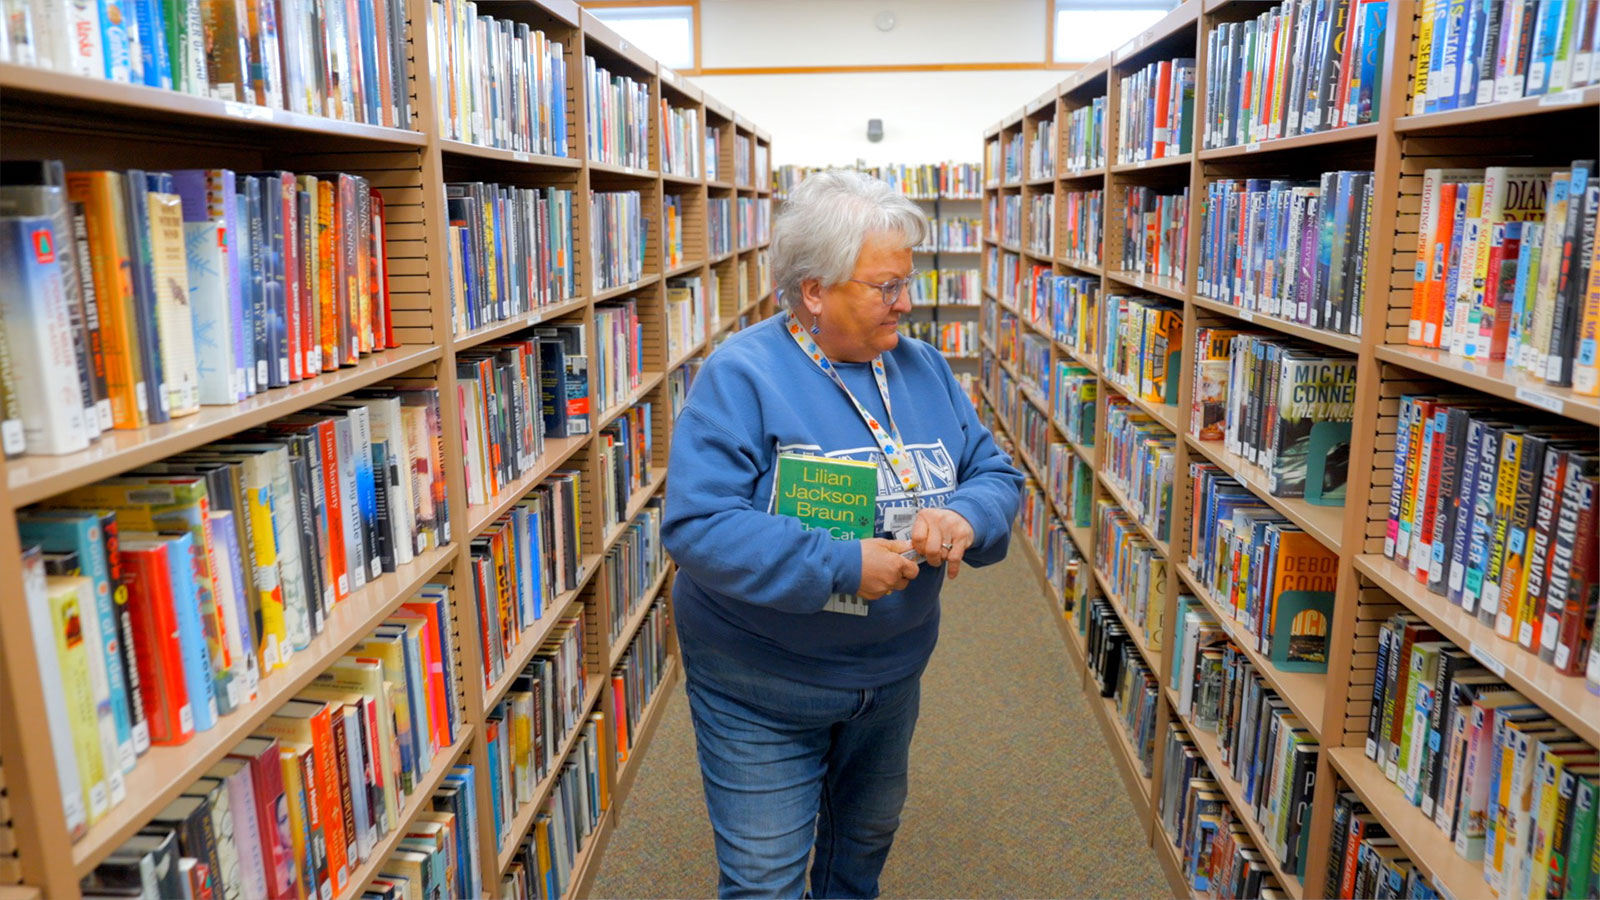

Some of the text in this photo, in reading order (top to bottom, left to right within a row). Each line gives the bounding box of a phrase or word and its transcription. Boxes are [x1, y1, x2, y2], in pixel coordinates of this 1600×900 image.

[1416, 43, 1431, 95] SENTRY
[358, 181, 368, 239] MONING
[1420, 177, 1433, 231] CHOPPING
[1483, 176, 1495, 217] STICKS
[73, 215, 86, 237] THE
[346, 210, 354, 266] MONING
[1305, 230, 1313, 268] CLEEVES
[1476, 229, 1488, 270] SCONES
[77, 241, 99, 331] IMMORTALISTS
[305, 239, 313, 290] REUNION
[1292, 404, 1314, 419] THE
[329, 462, 339, 509] Moriarty
[350, 480, 358, 503] Big
[785, 484, 868, 507] Jackson
[803, 467, 852, 487] Lilian
[1389, 466, 1404, 516] DEAVER
[1401, 469, 1415, 517] DEAVER
[1440, 445, 1458, 497] DEAVER
[351, 503, 361, 541] Little
[796, 502, 855, 522] Braun
[1513, 469, 1534, 528] DEAVER
[831, 526, 855, 541] Cat
[1453, 506, 1469, 562] DEAVER
[1468, 504, 1488, 564] DEAVER
[1527, 532, 1549, 597] DEAVER
[1547, 549, 1574, 610] DEAVER
[1437, 654, 1447, 691] DAMAGE
[305, 754, 314, 788] Walter
[310, 789, 320, 825] Mosley
